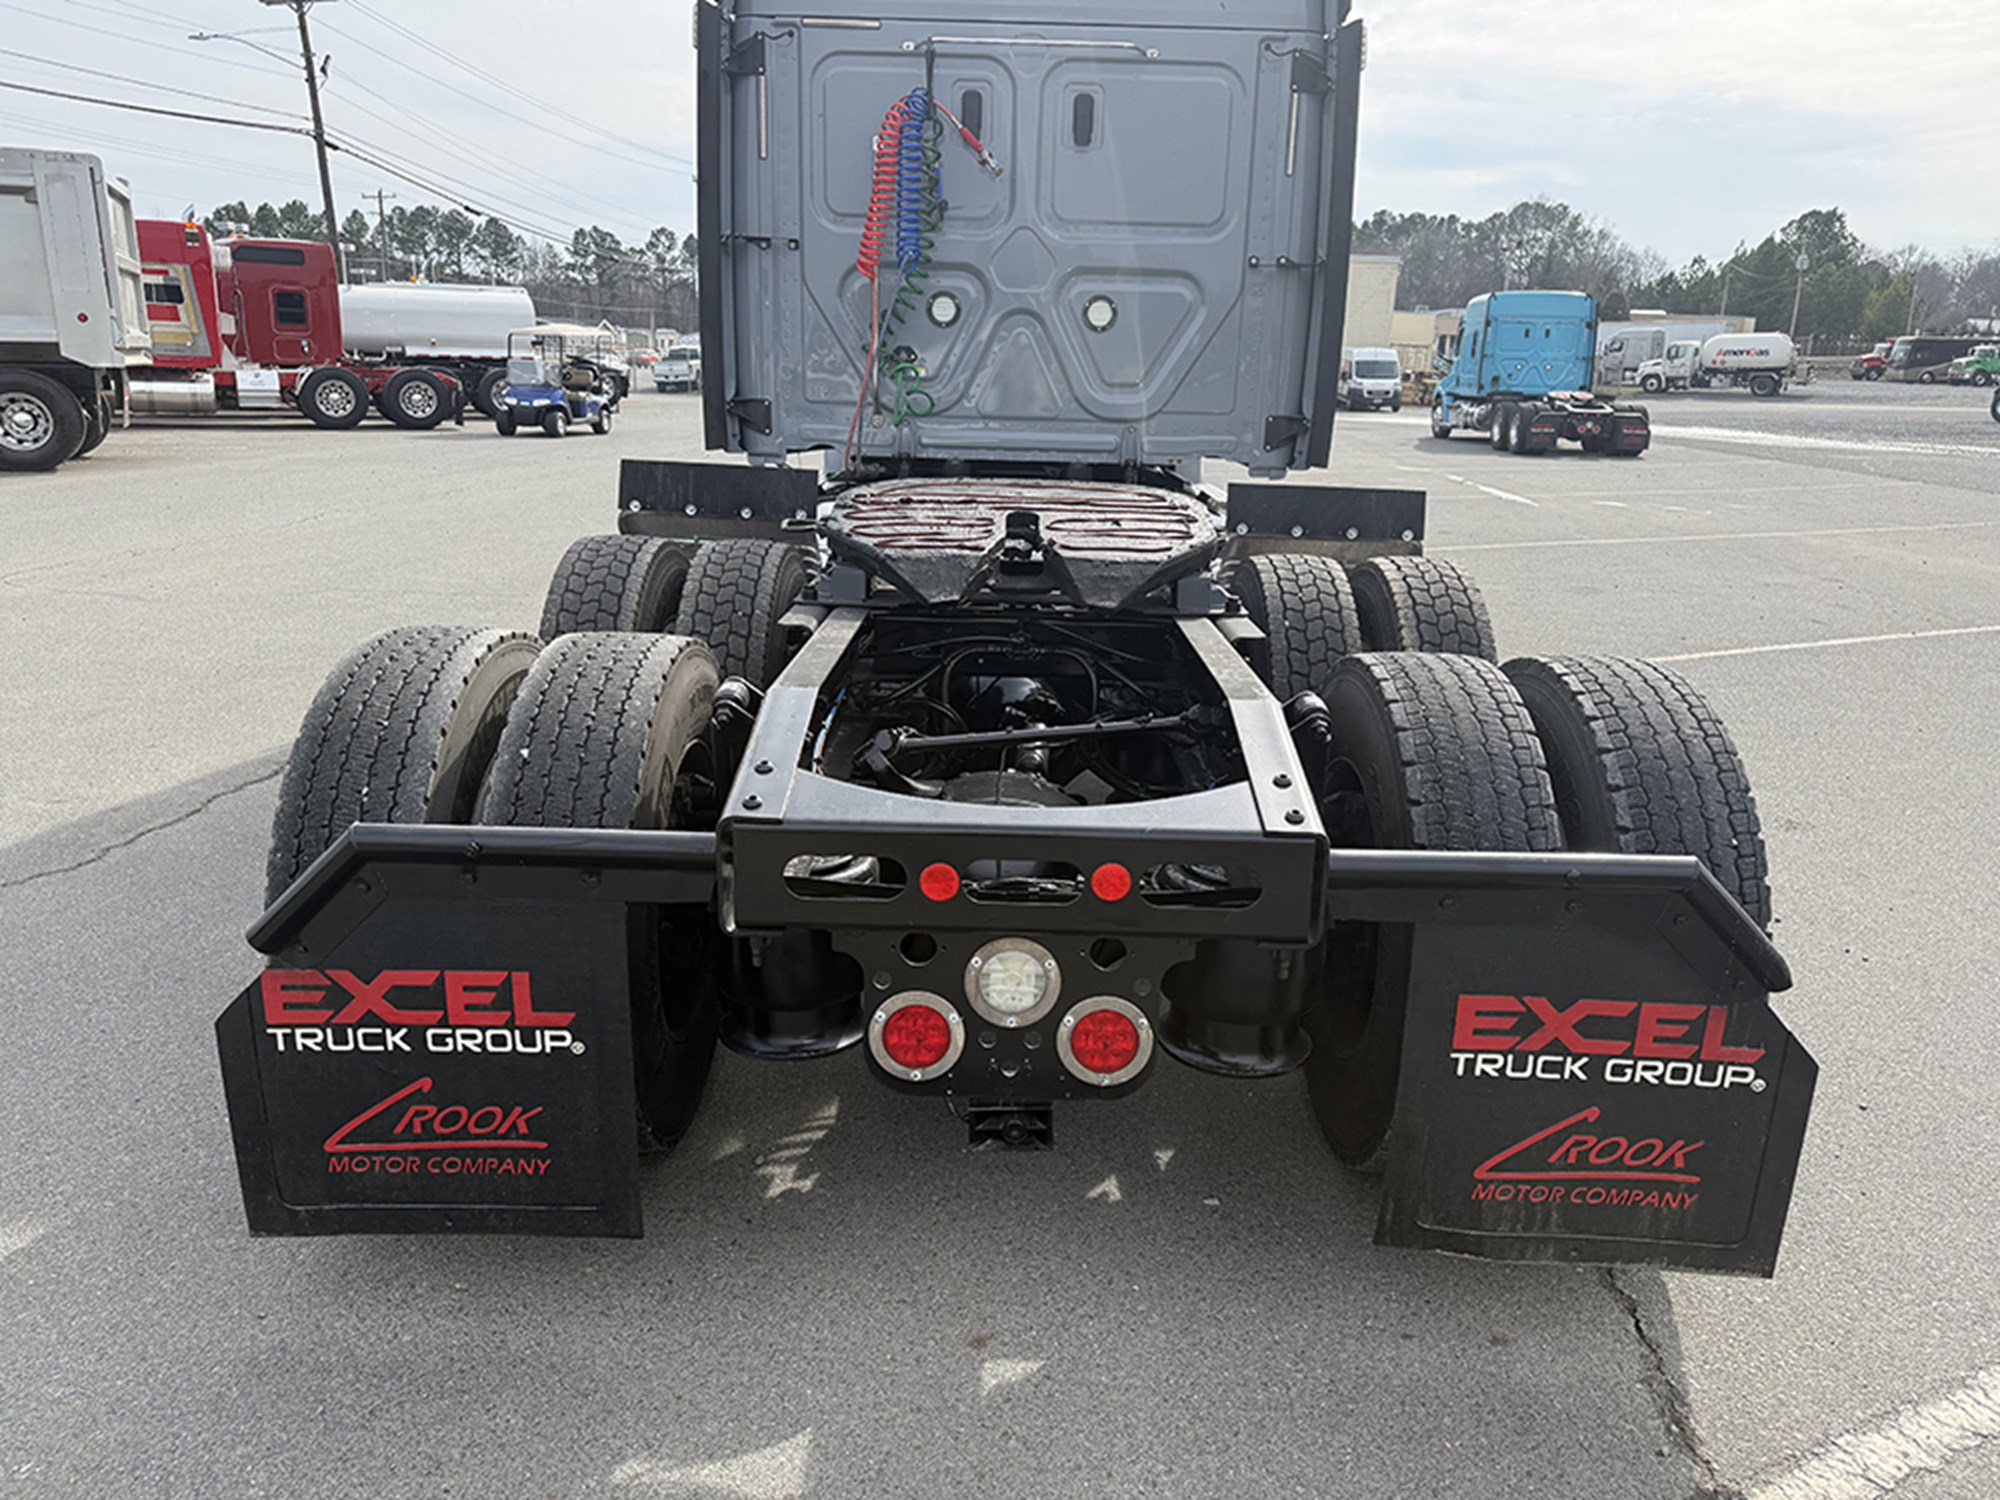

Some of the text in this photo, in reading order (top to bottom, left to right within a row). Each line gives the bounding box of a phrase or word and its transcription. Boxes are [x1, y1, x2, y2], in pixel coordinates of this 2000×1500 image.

[260, 969, 576, 1026] EXCEL
[266, 1027, 412, 1052] TRUCK
[1452, 994, 1766, 1063] EXCEL
[1450, 1052, 1590, 1081] TRUCK
[328, 1156, 551, 1176] MOTOR COMPANY
[1471, 1183, 1699, 1210] MOTOR COMPANY
